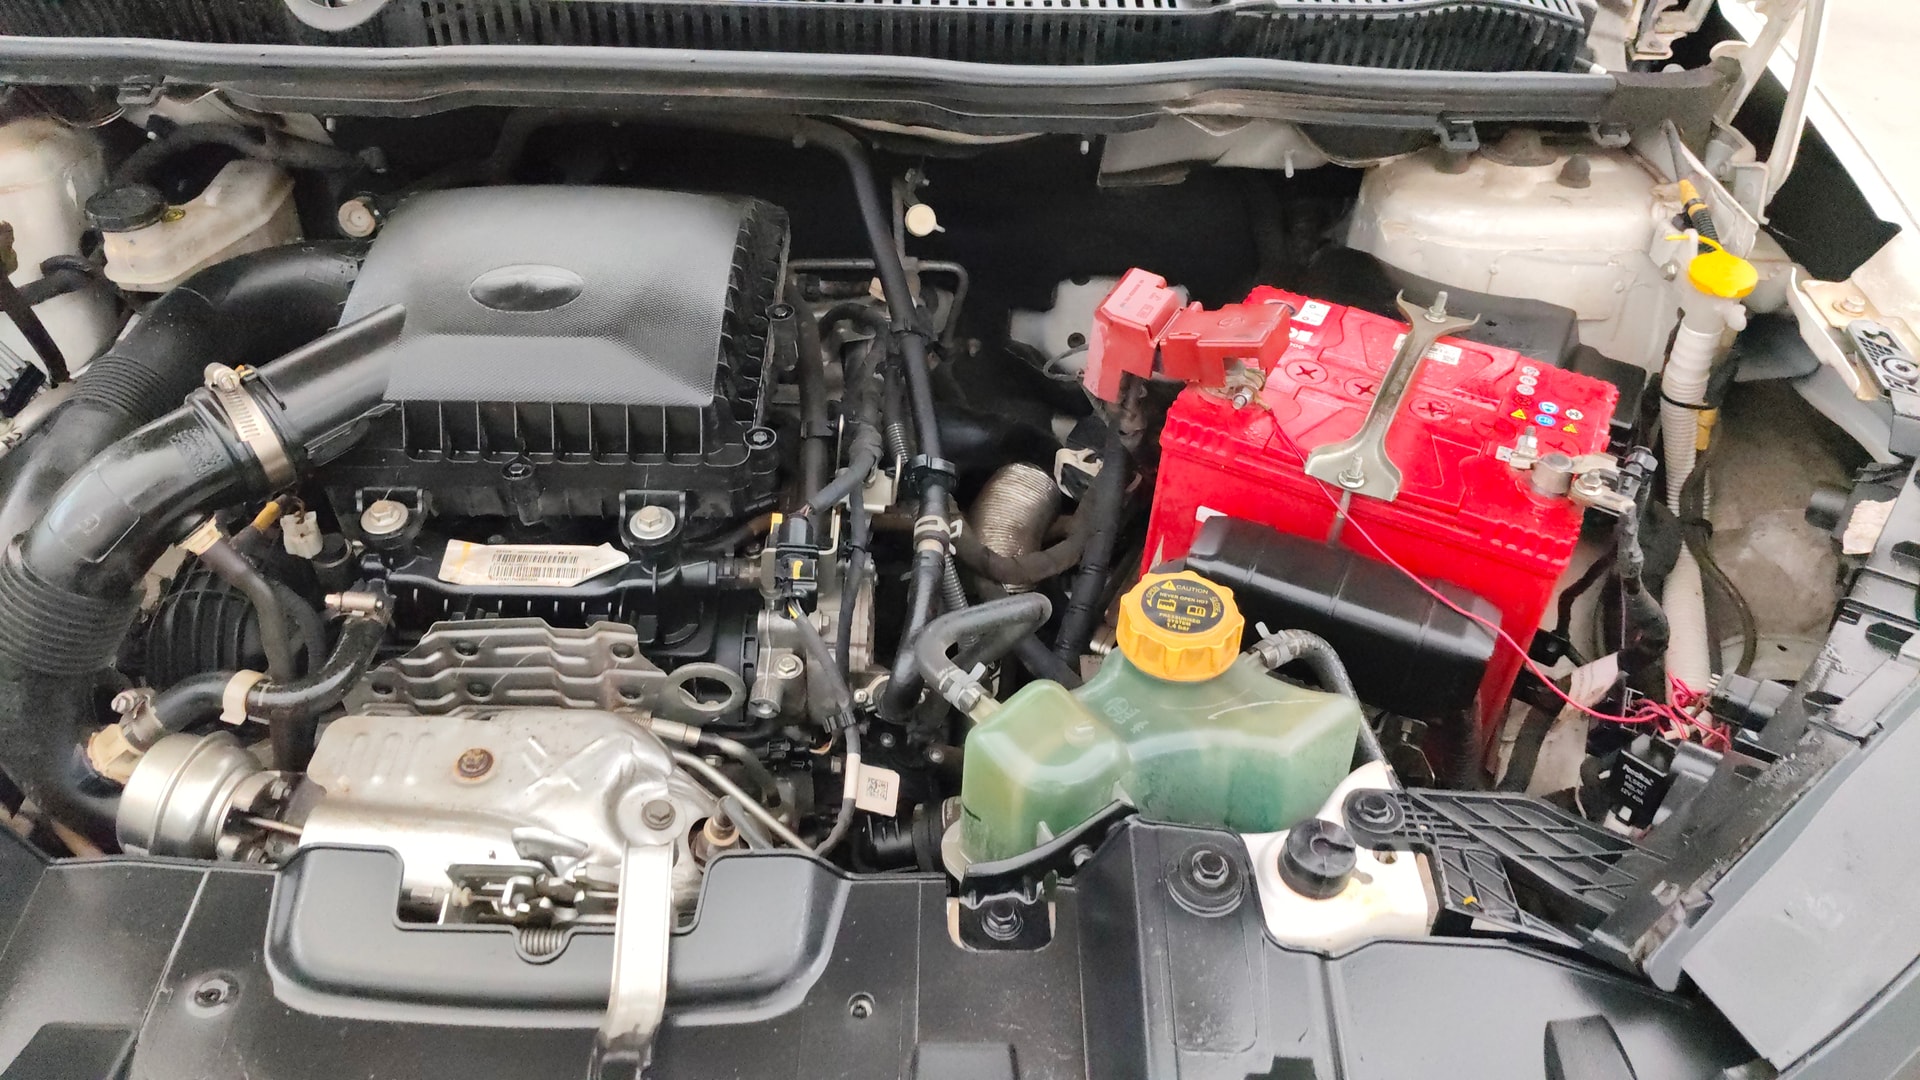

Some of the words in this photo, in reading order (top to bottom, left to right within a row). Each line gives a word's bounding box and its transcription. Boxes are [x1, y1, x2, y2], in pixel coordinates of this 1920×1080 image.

[1146, 586, 1160, 597] OPEN
[1176, 585, 1208, 594] CAUTION
[1160, 592, 1179, 600] NEVER
[1179, 595, 1195, 603] OPEN
